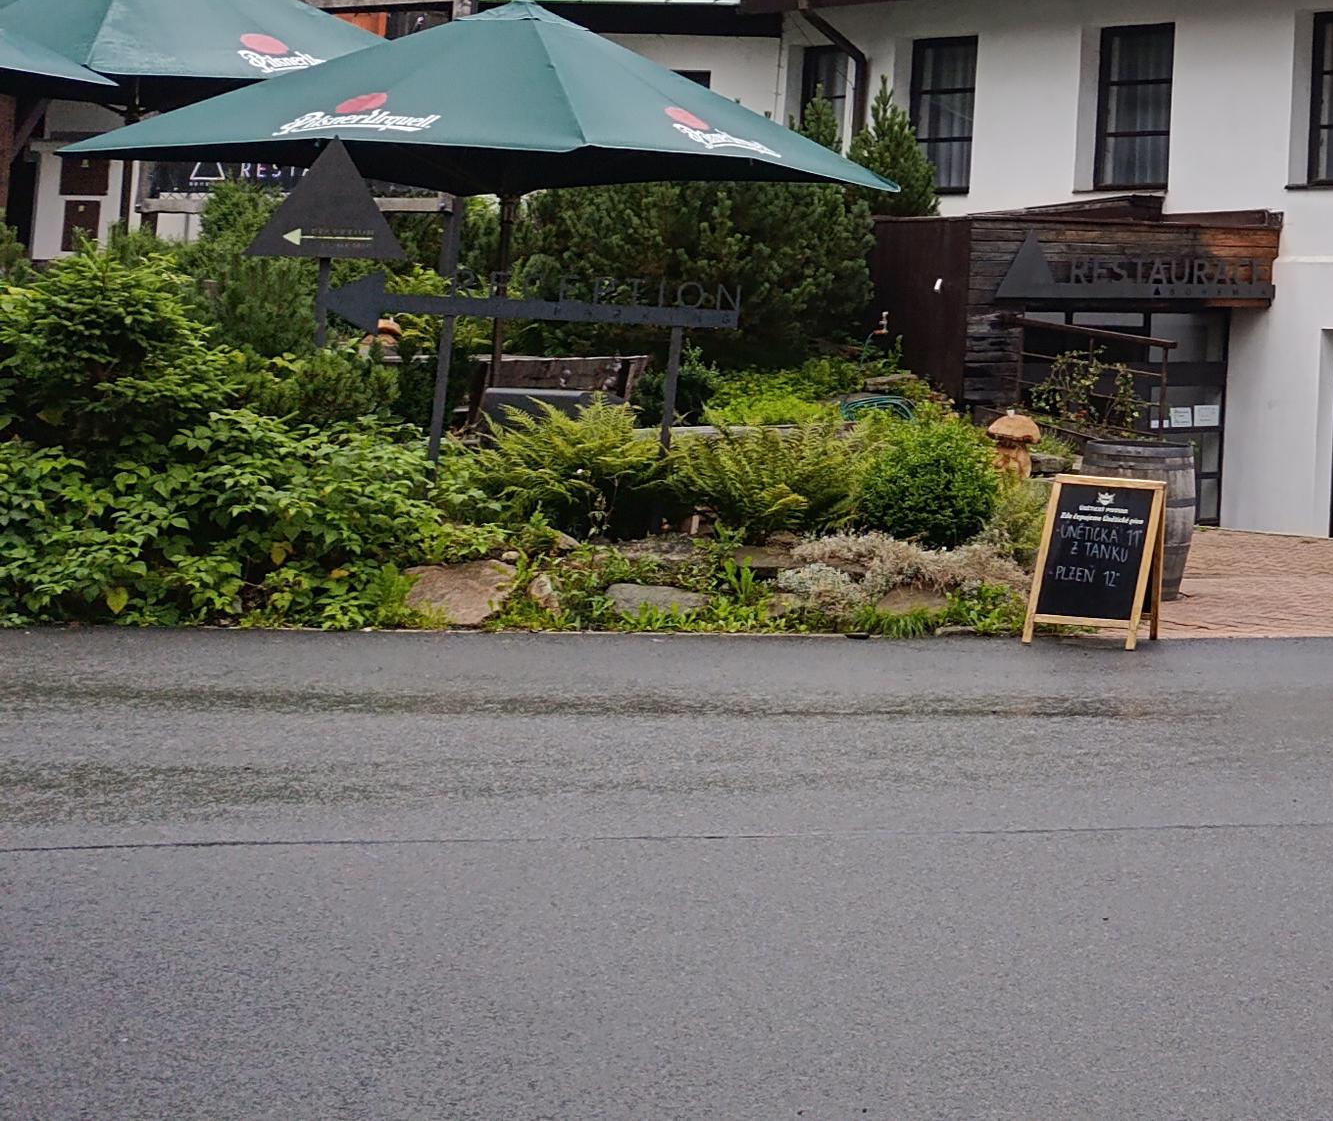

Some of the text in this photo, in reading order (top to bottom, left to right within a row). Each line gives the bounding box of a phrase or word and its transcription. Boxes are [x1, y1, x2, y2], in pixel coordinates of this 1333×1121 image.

[272, 111, 370, 136] Pilsner
[1069, 257, 1266, 284] RESTAURACE
[1084, 542, 1129, 563] TANKU
